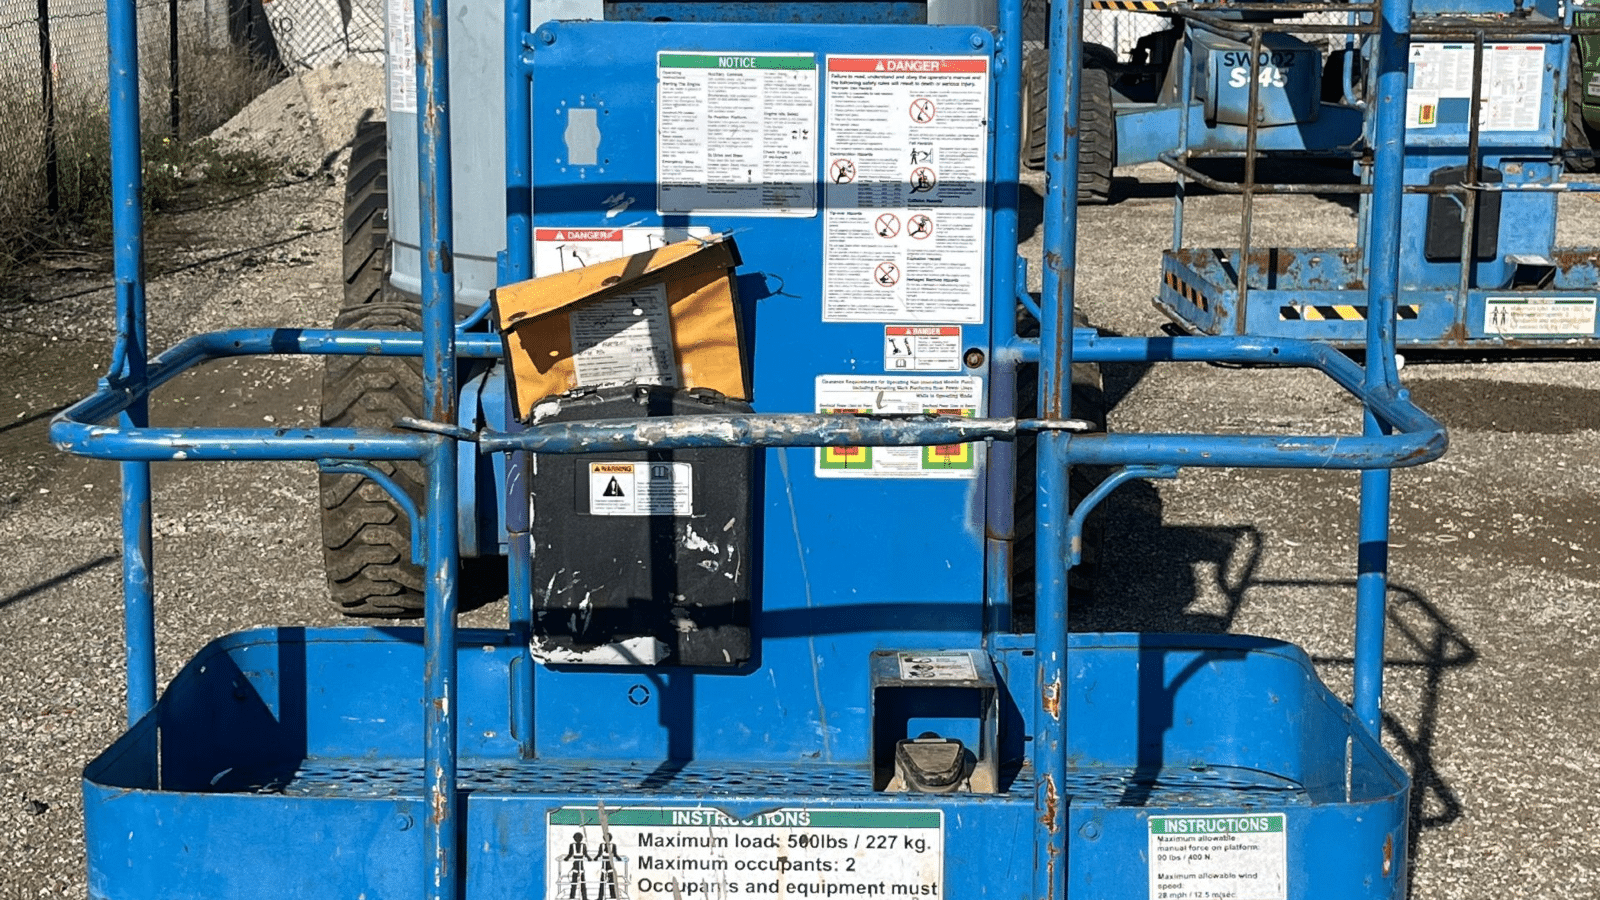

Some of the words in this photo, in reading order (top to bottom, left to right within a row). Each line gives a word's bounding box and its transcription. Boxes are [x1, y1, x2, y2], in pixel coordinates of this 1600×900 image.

[718, 57, 757, 68] NOTICE
[887, 60, 940, 72] DANGER
[1224, 52, 1295, 67] SW002
[567, 231, 607, 240] DANGER
[912, 328, 941, 336] DANGER
[1164, 817, 1269, 833] INSTRUCTIONS
[638, 833, 728, 848] Maximum
[736, 833, 780, 848] load:
[787, 834, 848, 849] 500lbs
[854, 834, 860, 849] /
[866, 835, 898, 849] 227
[904, 835, 931, 853] kg.
[1198, 834, 1236, 842] allowable
[638, 855, 728, 870] Maximum
[734, 856, 838, 875] occupants:
[845, 857, 856, 871] 2
[745, 879, 780, 893] and
[786, 880, 885, 897] equipment
[891, 882, 938, 896] must
